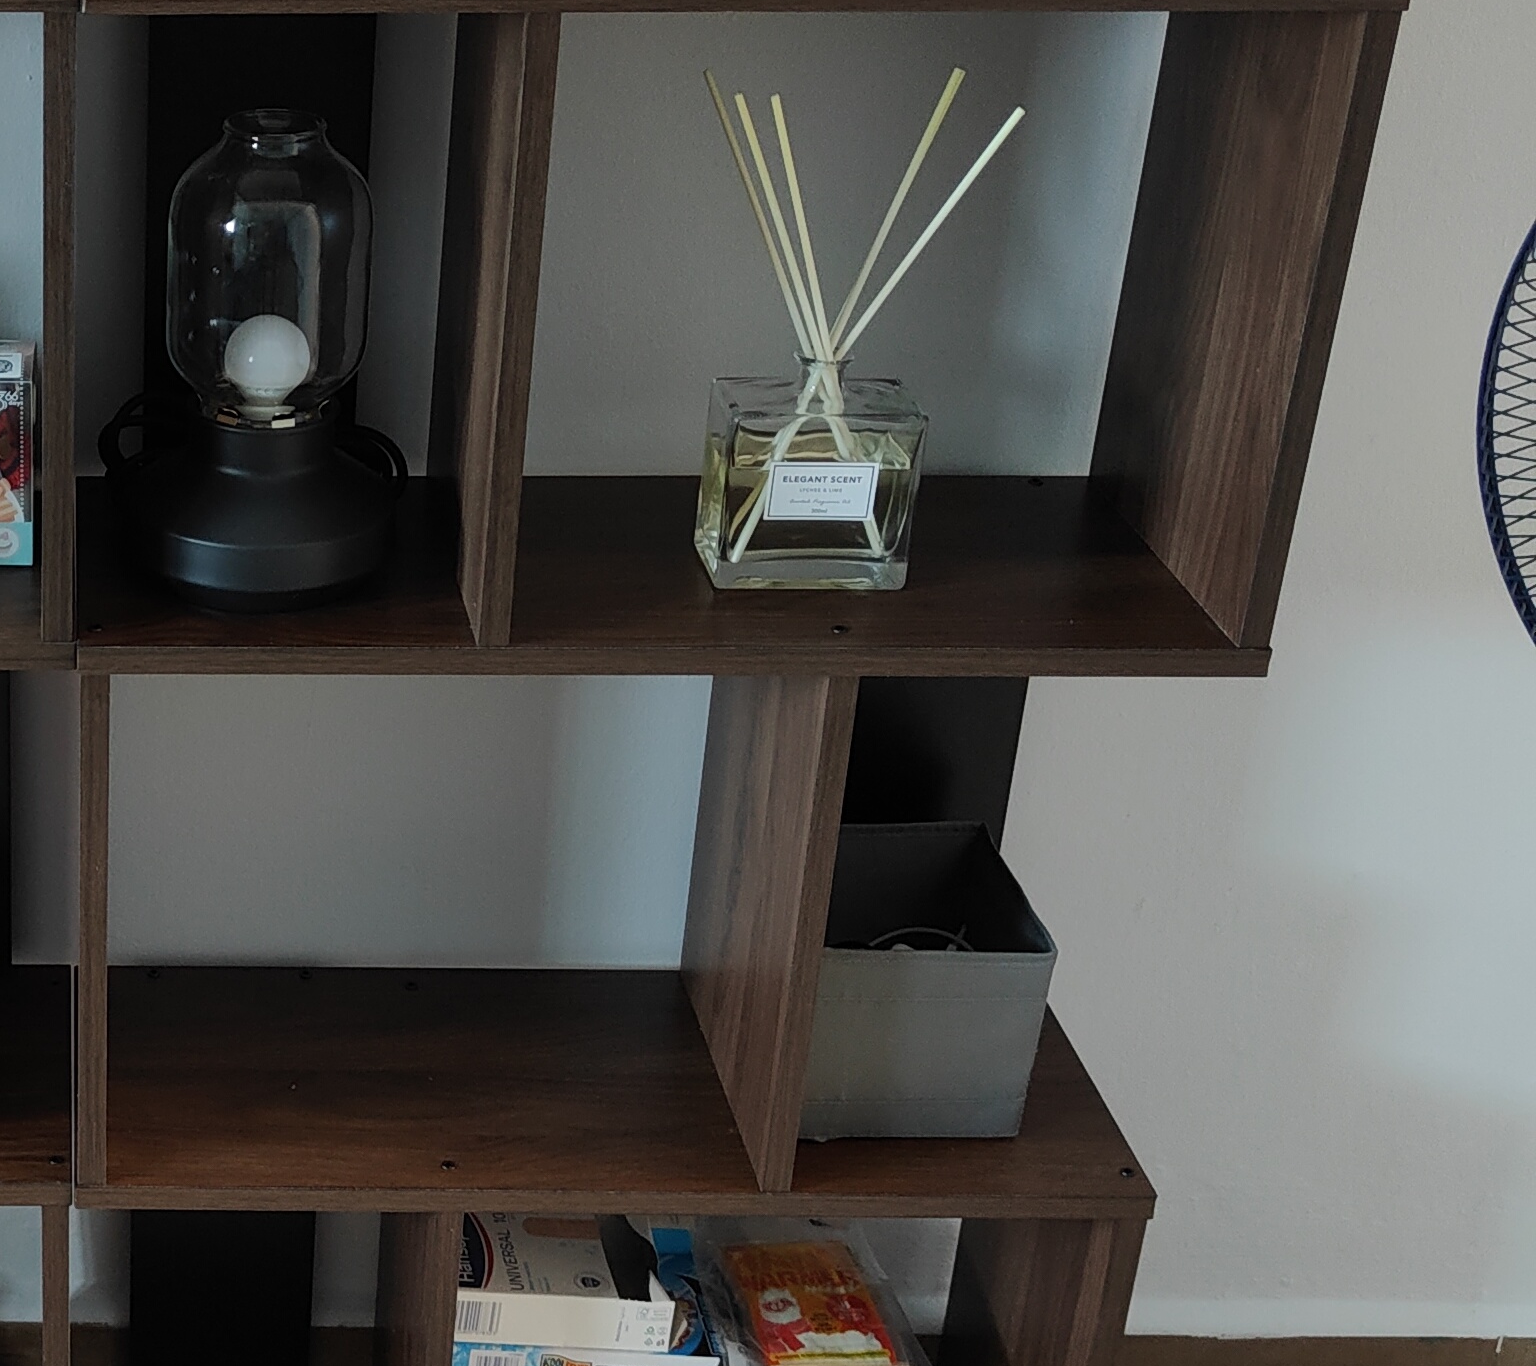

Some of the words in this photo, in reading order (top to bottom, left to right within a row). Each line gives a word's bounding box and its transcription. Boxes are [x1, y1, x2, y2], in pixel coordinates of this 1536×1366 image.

[783, 475, 828, 483] ELEGANT
[830, 476, 863, 484] SCENT
[498, 1229, 525, 1291] UNIVERSAL
